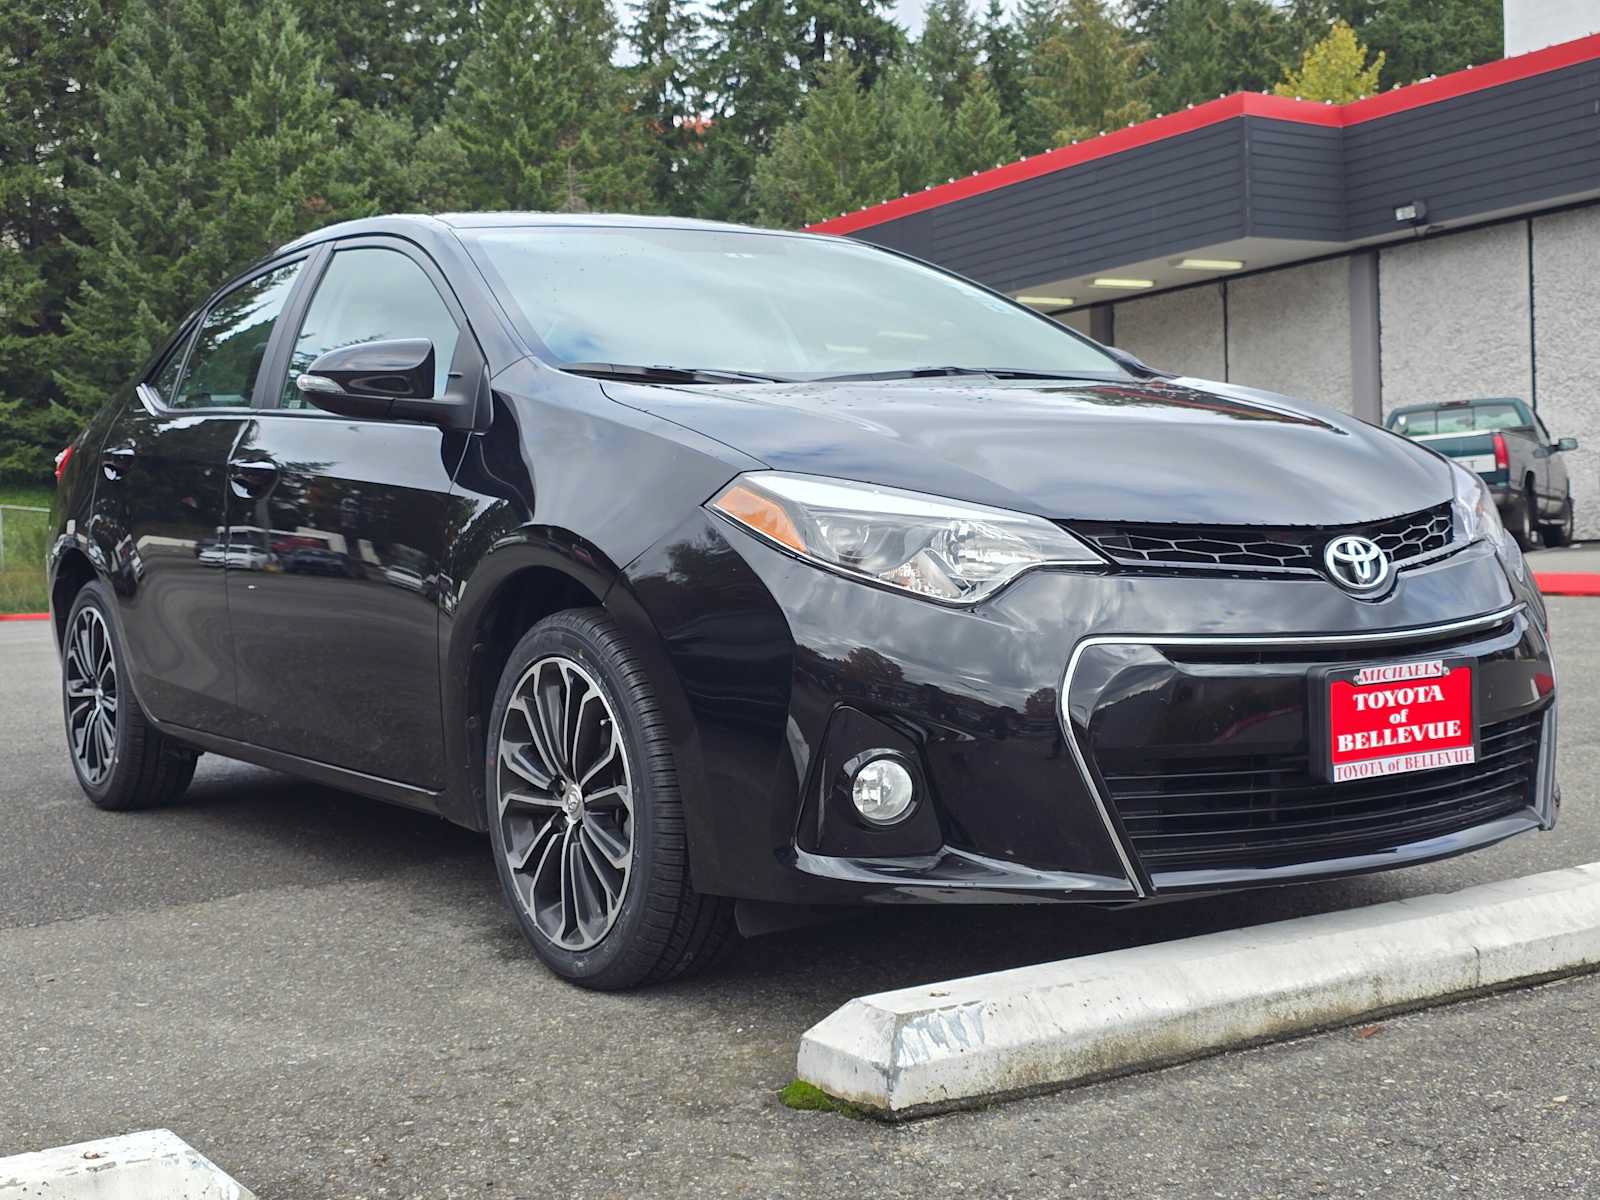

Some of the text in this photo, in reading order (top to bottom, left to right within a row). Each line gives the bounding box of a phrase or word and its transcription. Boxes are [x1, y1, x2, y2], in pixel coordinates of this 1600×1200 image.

[1361, 661, 1441, 683] MICHAELS
[1353, 685, 1445, 711] TOYOTA
[1389, 709, 1408, 724] of
[1337, 720, 1461, 752] BELLEVUE
[1335, 749, 1473, 780] TOYOTA of BELLEVUE
